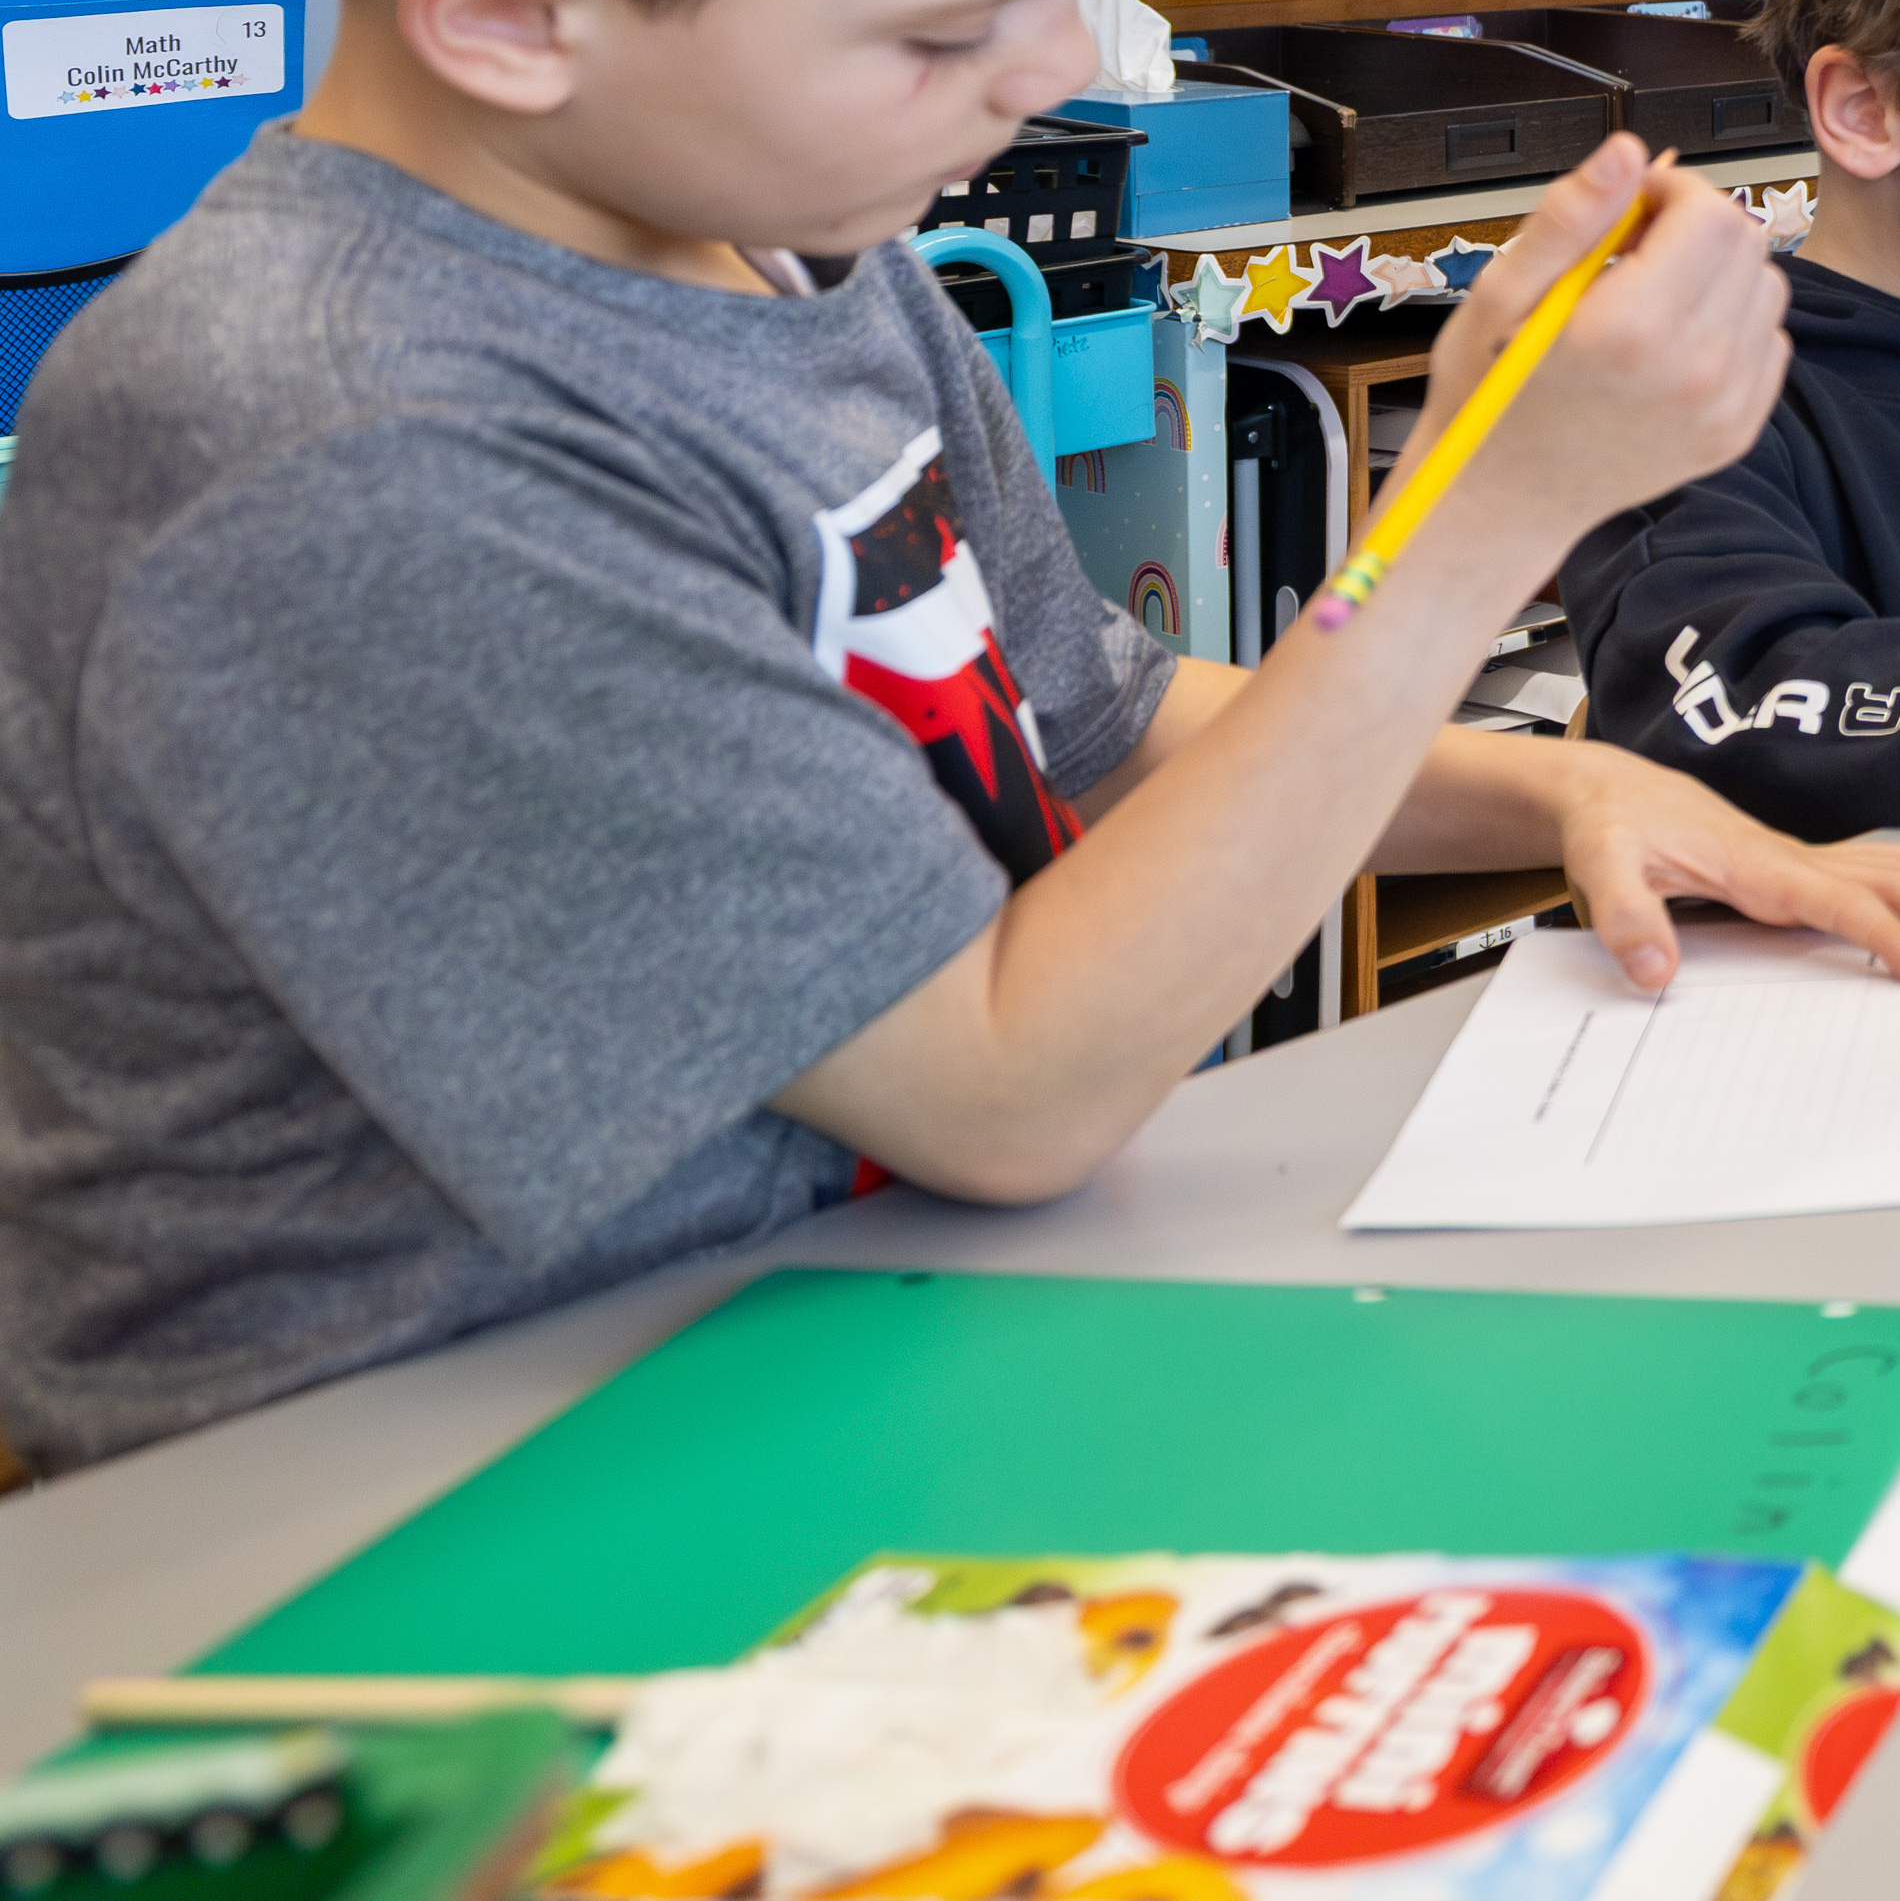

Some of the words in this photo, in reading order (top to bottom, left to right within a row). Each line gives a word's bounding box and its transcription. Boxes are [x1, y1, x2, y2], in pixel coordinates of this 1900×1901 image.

[242, 20, 267, 39] 13
[126, 34, 181, 56] Math
[67, 65, 124, 87] Colin
[133, 55, 239, 81] McCarthy
[1497, 925, 1514, 942] 16
